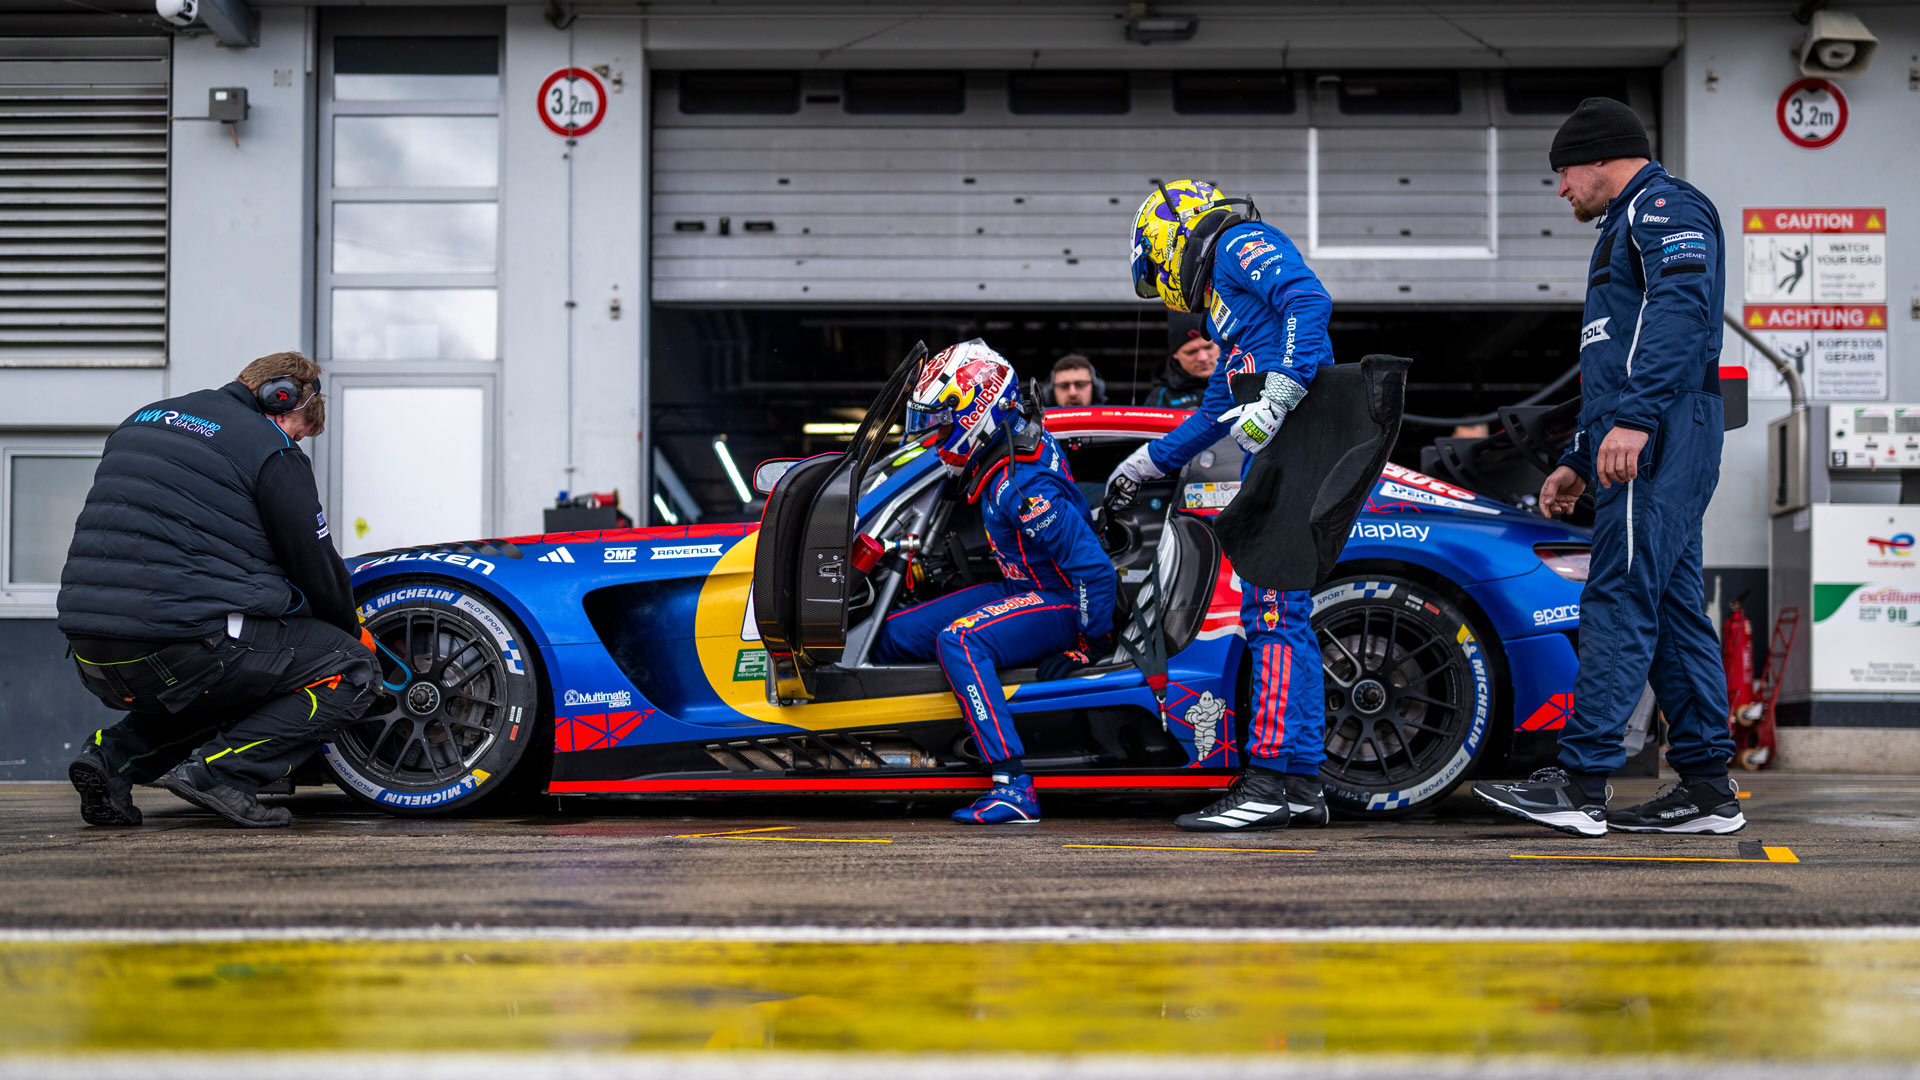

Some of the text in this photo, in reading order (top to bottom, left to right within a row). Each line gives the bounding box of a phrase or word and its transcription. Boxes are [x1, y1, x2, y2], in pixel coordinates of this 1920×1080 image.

[1775, 213, 1854, 229] CAUTION
[1829, 243, 1869, 253] WATCH
[1817, 255, 1882, 265] YOUR HEAD
[1768, 309, 1864, 326] ACHTUNG
[1283, 332, 1296, 364] Player
[1825, 352, 1875, 363] GEFAHR
[959, 372, 1005, 430] Red Bull
[174, 420, 215, 437] RACING
[180, 413, 221, 431] WINWARD
[1033, 500, 1051, 517] Bull
[1349, 522, 1430, 542] viaplay
[604, 548, 637, 561] OMP
[657, 547, 716, 556] RAVENOL
[352, 552, 496, 576] FALKEN
[984, 592, 1044, 616] Red Bull
[1318, 589, 1345, 605] SPORT
[377, 588, 504, 635] MICHELIN PILOT SPORT
[1533, 604, 1580, 626] sparc
[580, 690, 631, 703] Multimatic
[967, 684, 988, 721] sparco
[1418, 659, 1488, 797] MICHELIN PILOT SPORT
[333, 759, 461, 806] MICHELIN PILOT SPORT
